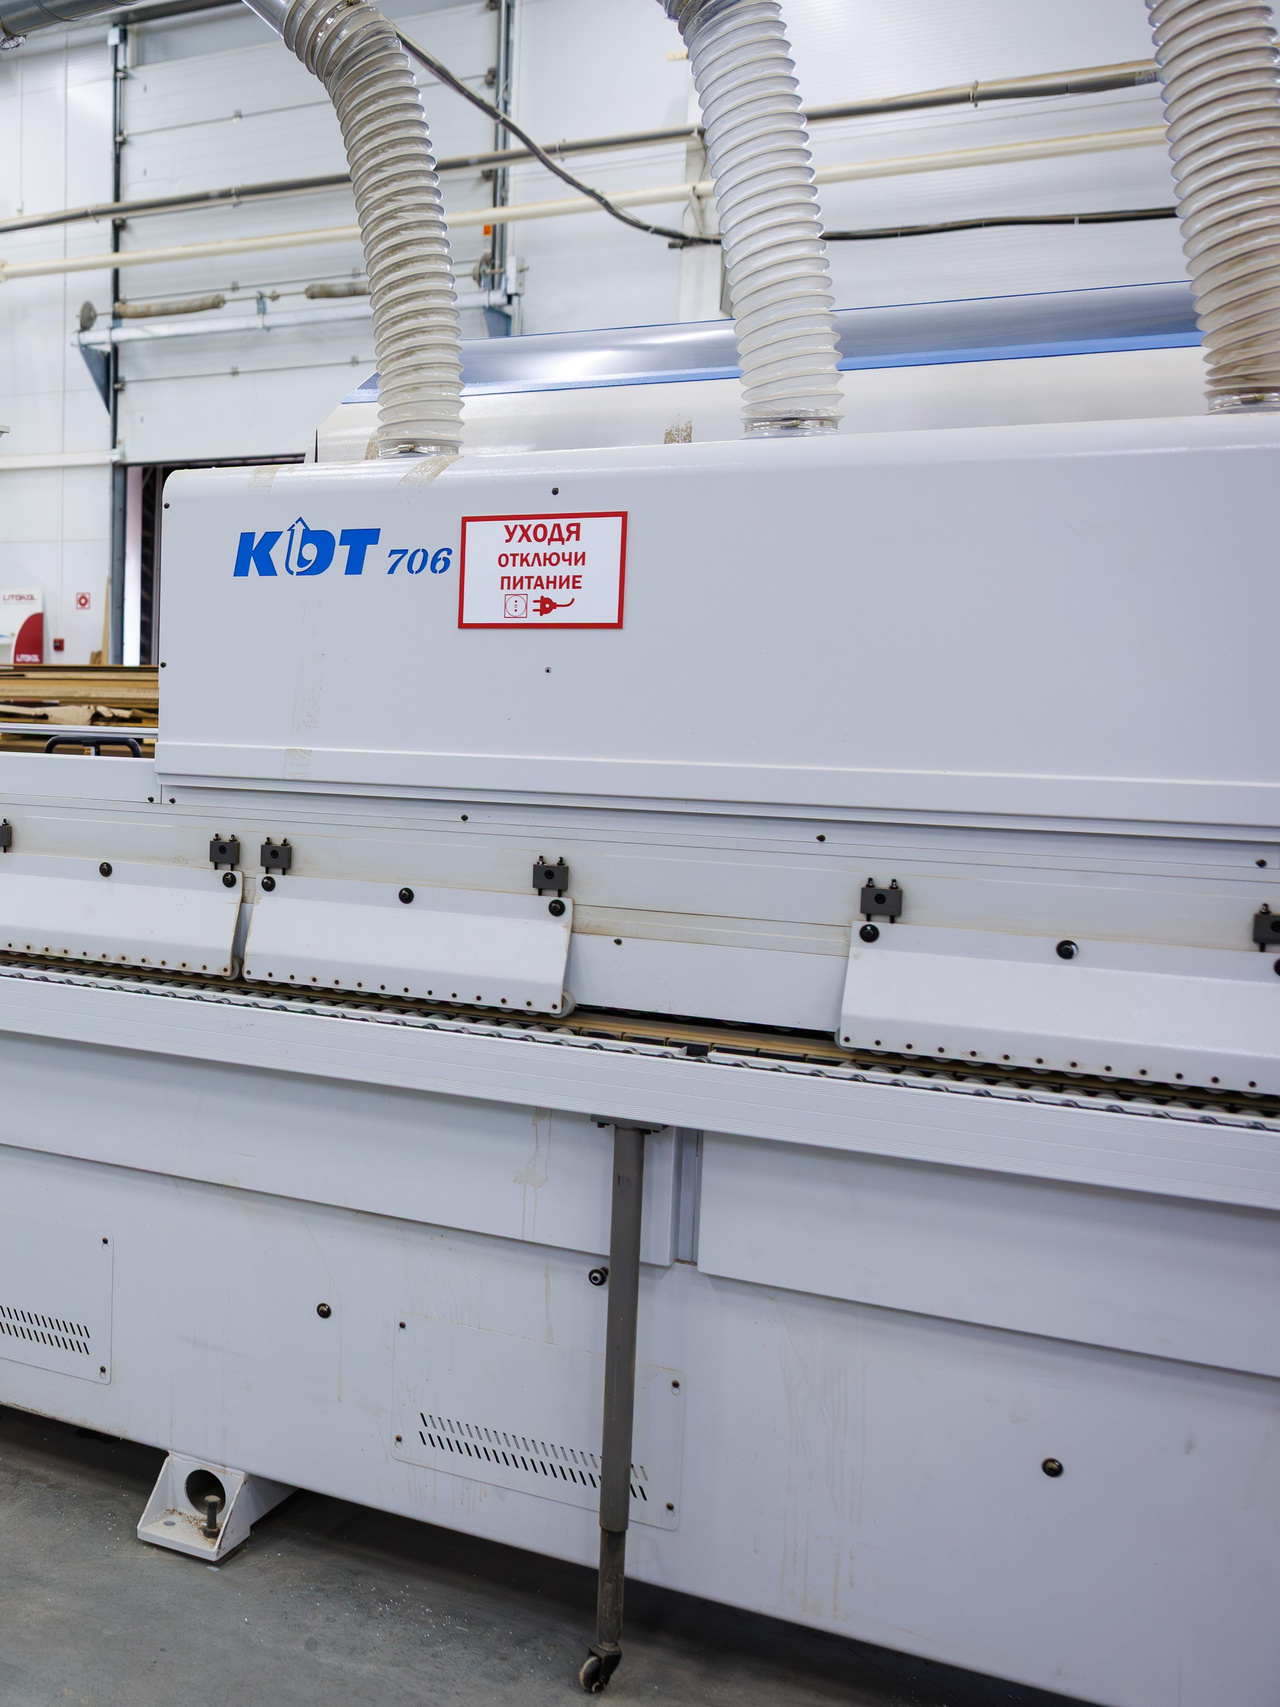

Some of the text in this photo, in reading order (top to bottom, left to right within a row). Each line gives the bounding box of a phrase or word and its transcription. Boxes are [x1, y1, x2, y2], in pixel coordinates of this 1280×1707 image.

[503, 522, 581, 546] УХОДЯ
[233, 517, 453, 577] KDT 706
[497, 551, 586, 568] ОТКЛЮЧИ
[500, 574, 583, 590] ПИТАНИЕ
